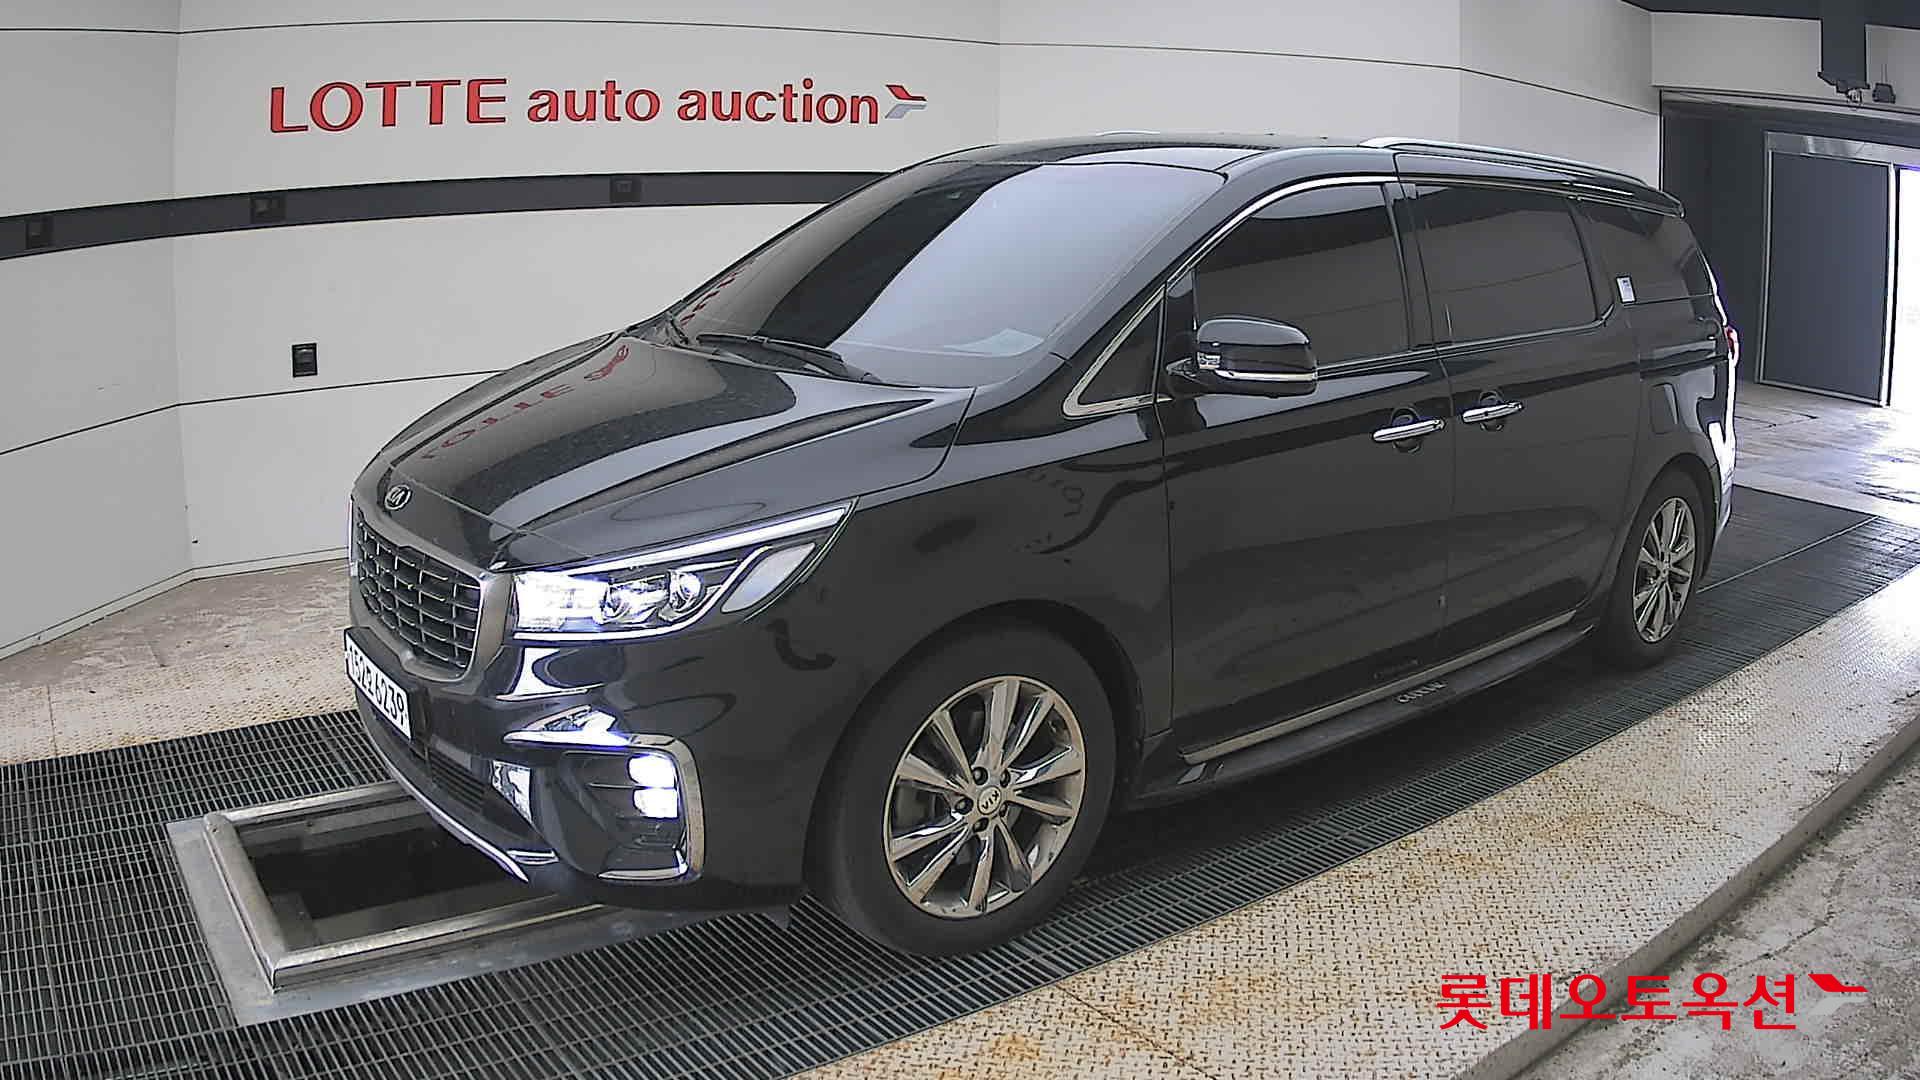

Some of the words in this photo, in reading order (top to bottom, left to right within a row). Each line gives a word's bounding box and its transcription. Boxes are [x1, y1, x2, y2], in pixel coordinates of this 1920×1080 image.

[269, 79, 507, 133] LOTTE
[527, 79, 661, 123] auto
[676, 77, 879, 126] auction
